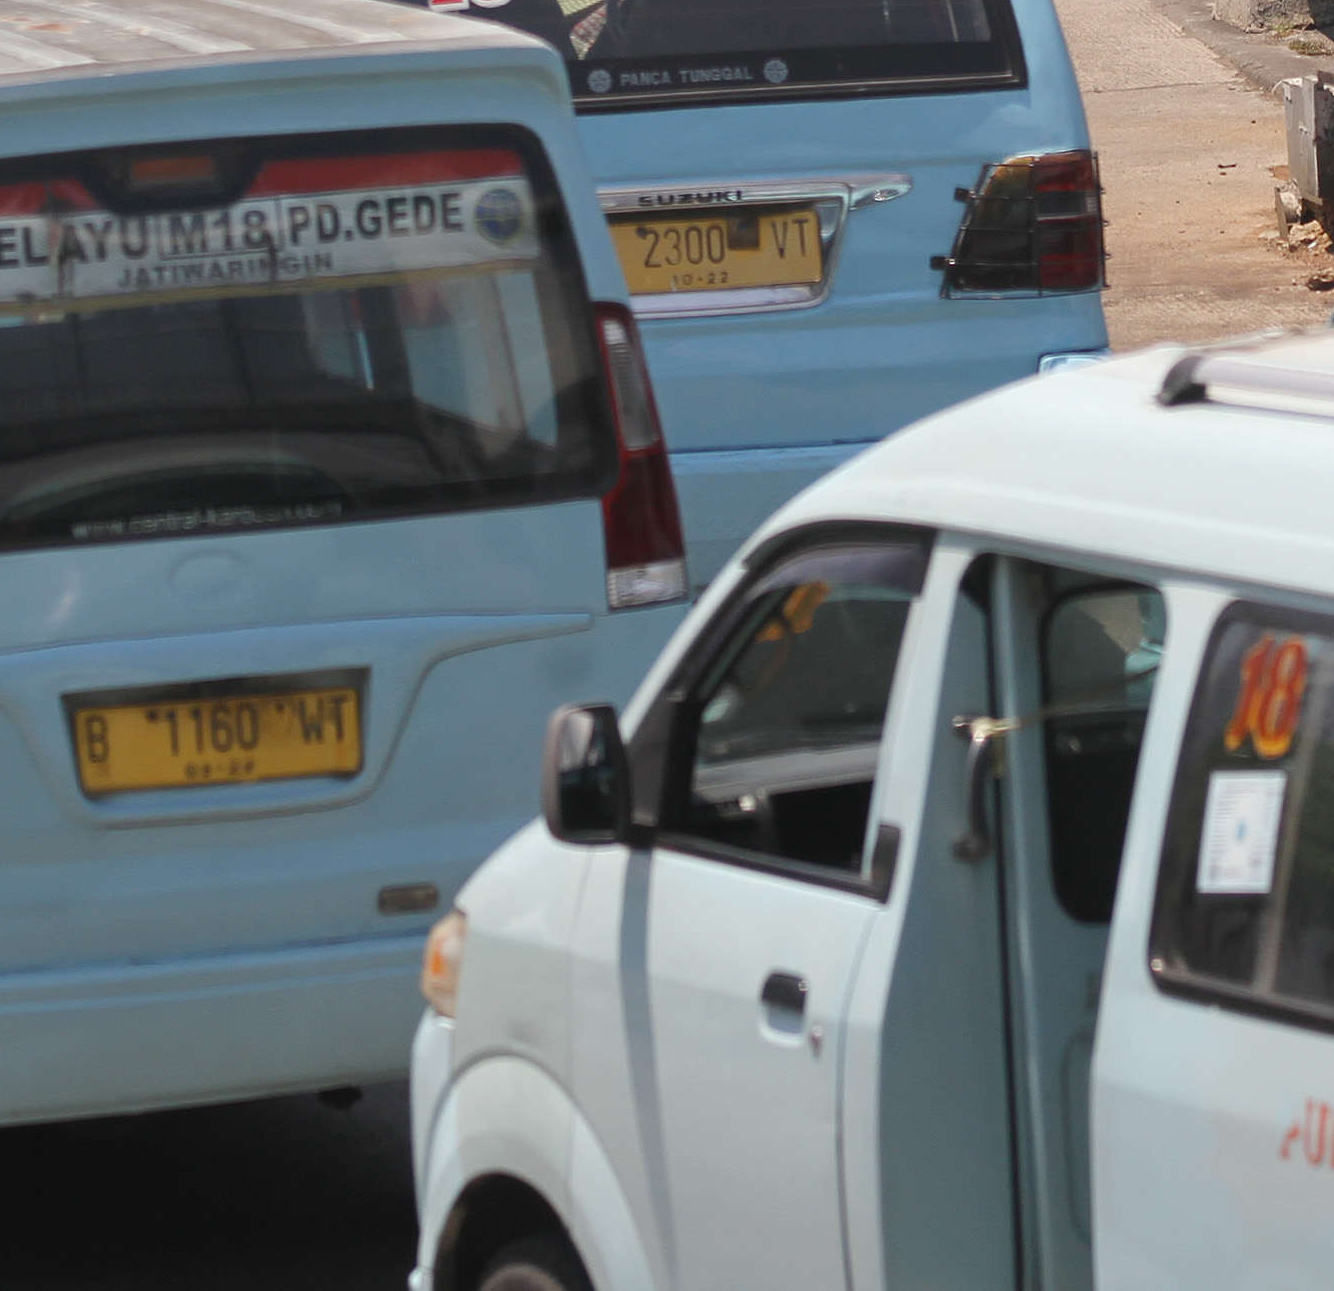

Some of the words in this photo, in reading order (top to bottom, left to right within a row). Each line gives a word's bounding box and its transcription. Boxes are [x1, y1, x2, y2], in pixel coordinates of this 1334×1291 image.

[620, 71, 672, 87] PANCA
[678, 66, 754, 83] TUNGGAL
[169, 208, 266, 258] M18
[288, 189, 465, 249] PD.GEDE
[637, 190, 742, 208] SUZUKI
[642, 224, 726, 269] 2300
[770, 218, 810, 260] VT
[1224, 628, 1309, 760] 18
[85, 714, 110, 764] B
[160, 701, 260, 757] 1160
